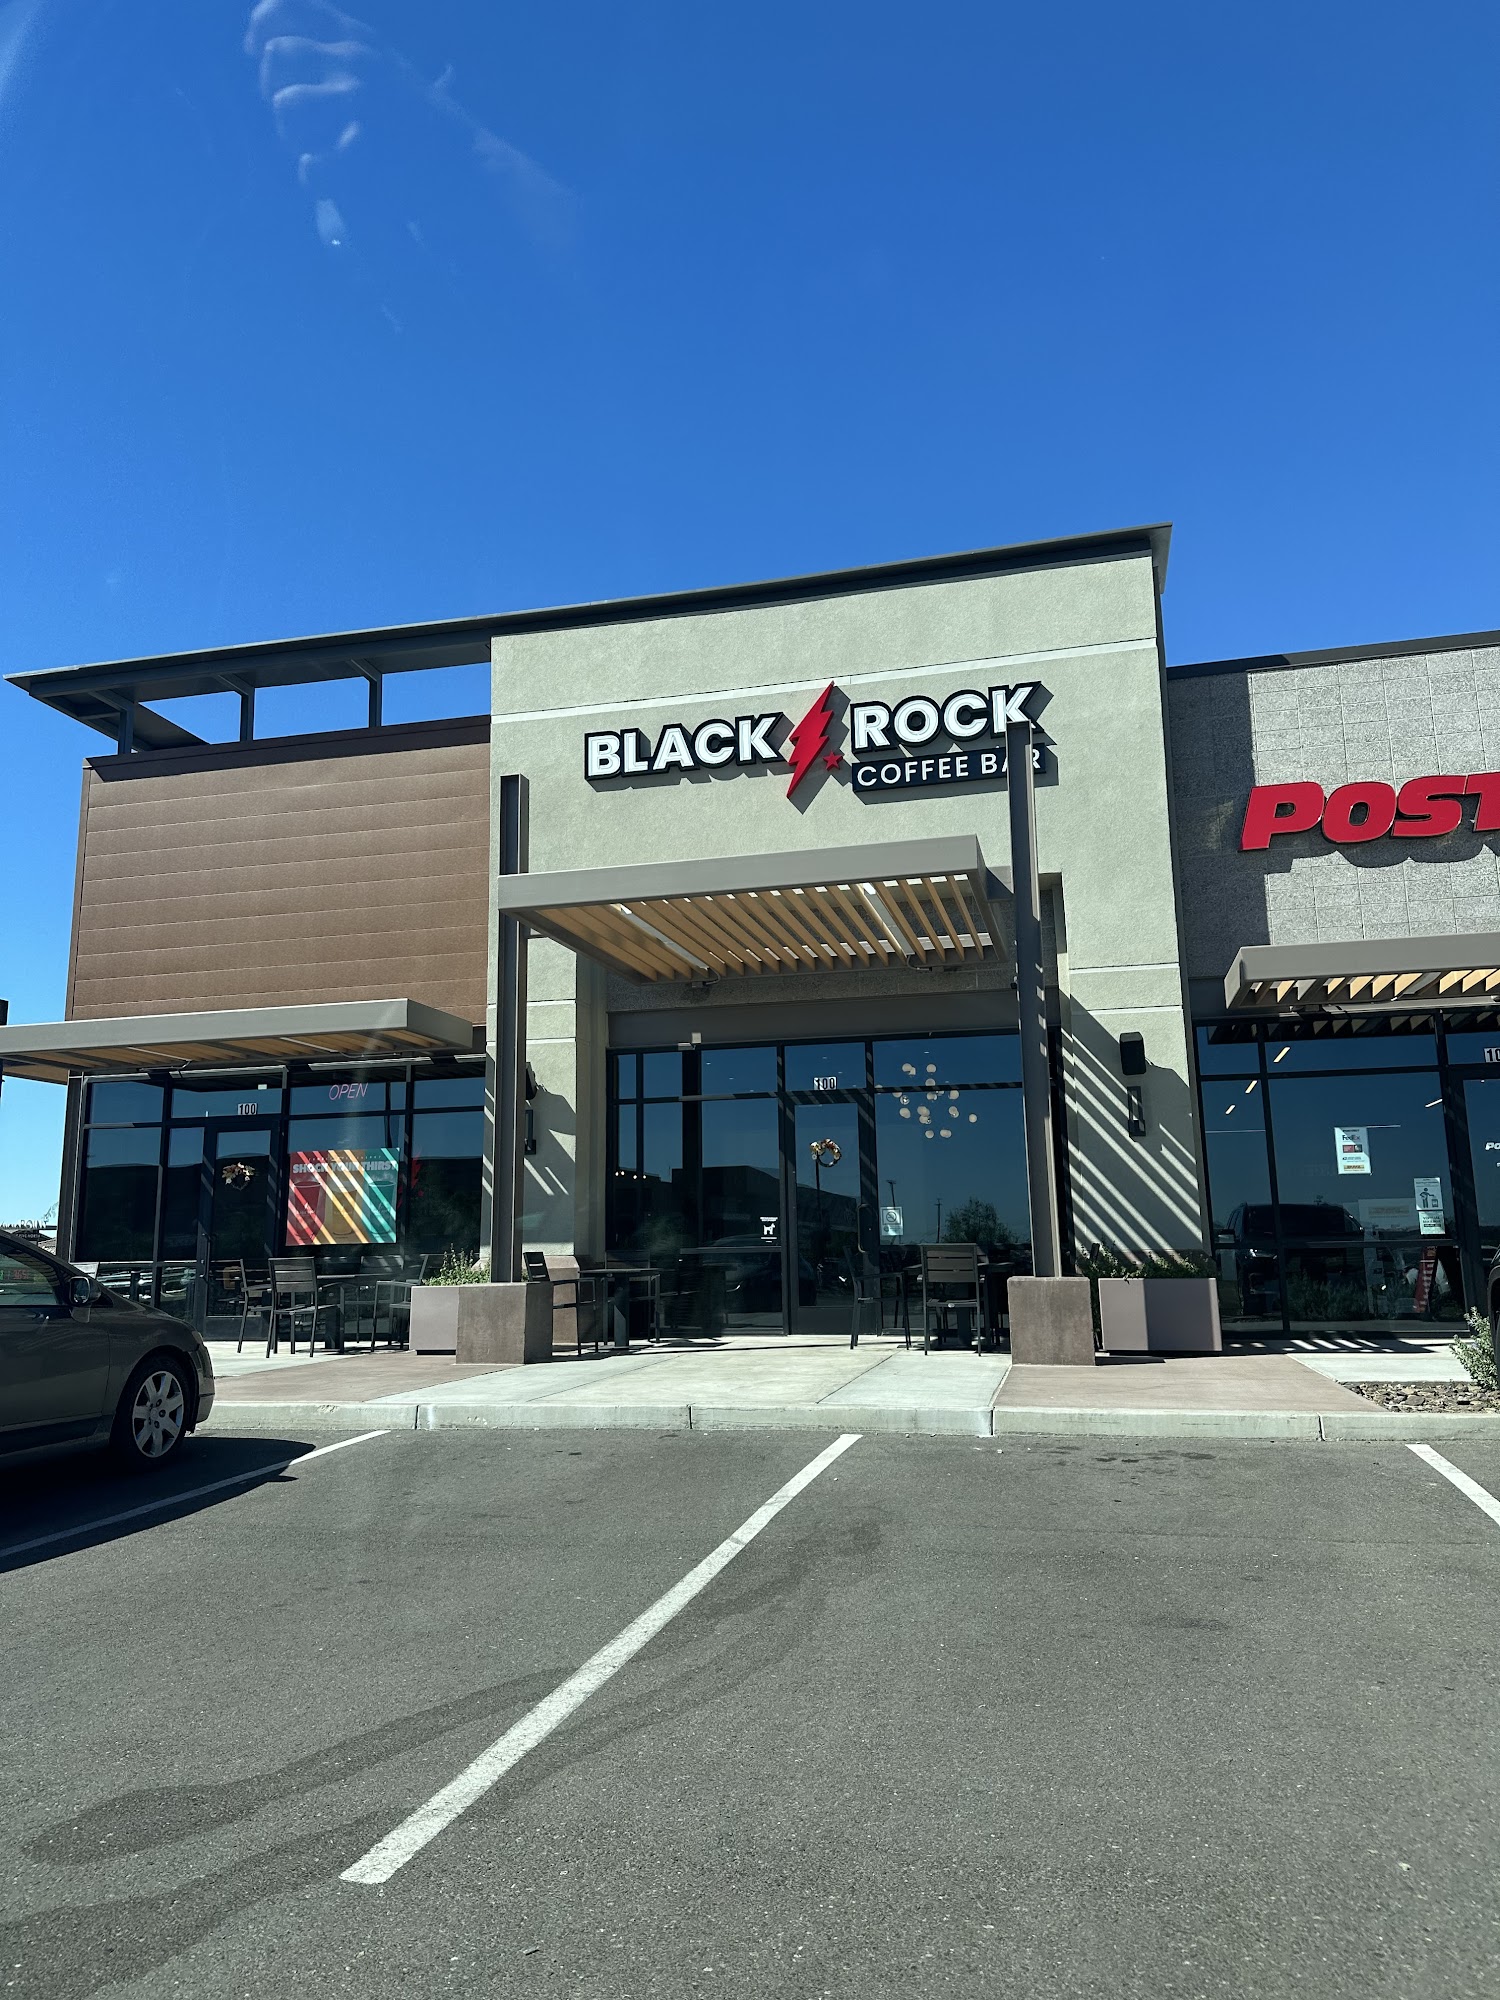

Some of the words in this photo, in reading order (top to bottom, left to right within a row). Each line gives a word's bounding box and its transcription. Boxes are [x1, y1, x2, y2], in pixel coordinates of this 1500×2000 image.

[586, 714, 783, 779] BLACK
[852, 684, 1041, 751] ROCK
[857, 756, 969, 786] COFFEE
[981, 748, 1041, 775] BR
[1239, 771, 1500, 851] POST
[328, 1083, 368, 1100] OPEN
[814, 1077, 836, 1090] 100
[239, 1103, 257, 1115] 100
[292, 1162, 328, 1174] SHOCK
[361, 1160, 397, 1171] THIRST
